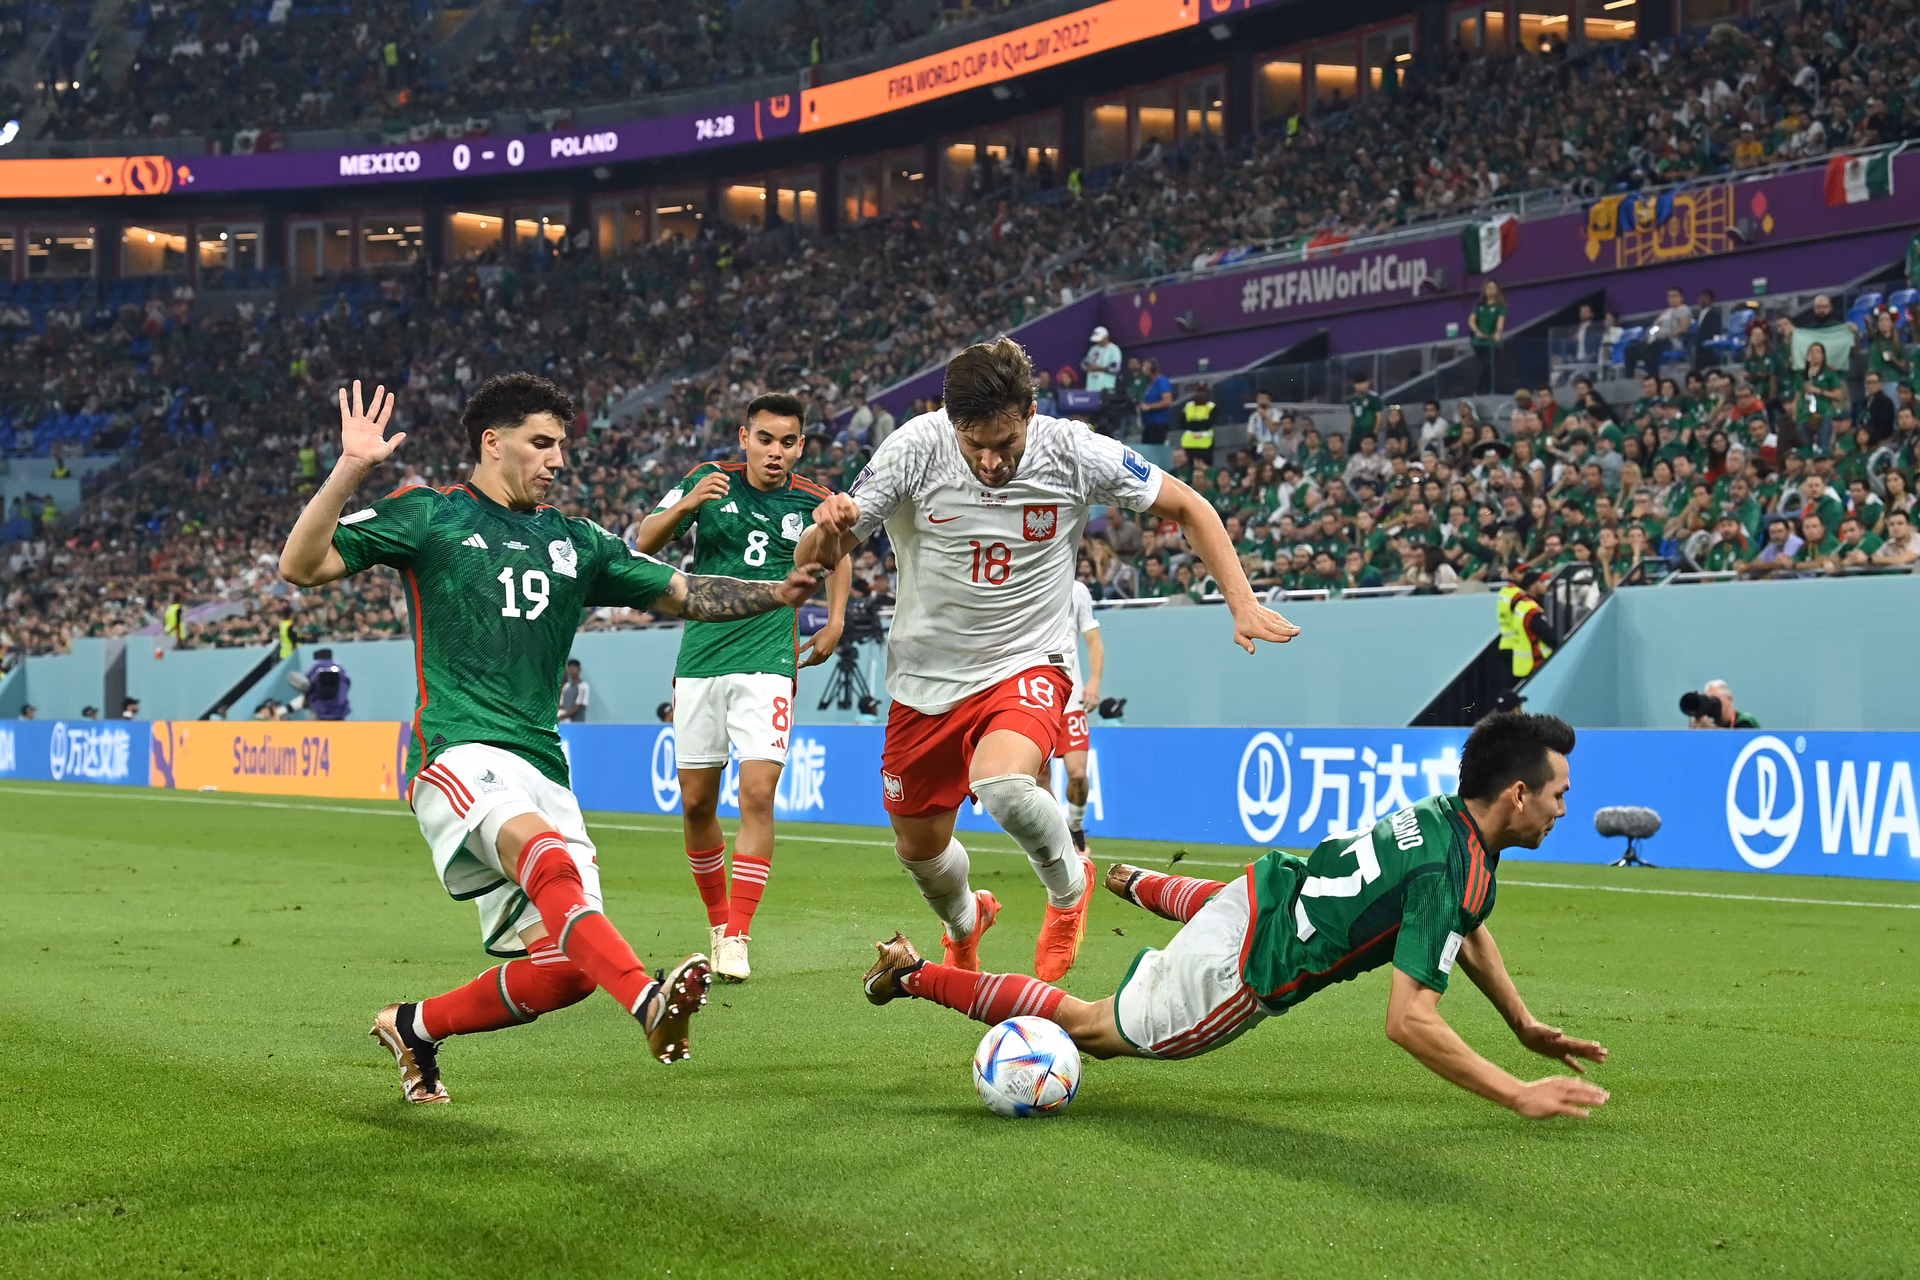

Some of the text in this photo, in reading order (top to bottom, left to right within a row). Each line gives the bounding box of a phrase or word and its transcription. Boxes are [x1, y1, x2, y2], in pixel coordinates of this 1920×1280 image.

[888, 75, 914, 100] FIFA
[916, 60, 960, 91] WORLD
[964, 52, 988, 78] CUP
[695, 114, 735, 141] 74:28
[339, 150, 421, 177] MEXICO
[452, 144, 471, 171] 0
[507, 139, 525, 166] 0
[550, 131, 618, 158] POLAND
[1241, 254, 1428, 313] #FIFAWorldCup
[743, 529, 770, 567] 8
[969, 540, 1013, 586] 18
[496, 566, 550, 621] 19
[1017, 675, 1055, 708] 18
[772, 695, 789, 732] 8
[1067, 715, 1090, 737] 20
[233, 734, 330, 777] Stadium 974
